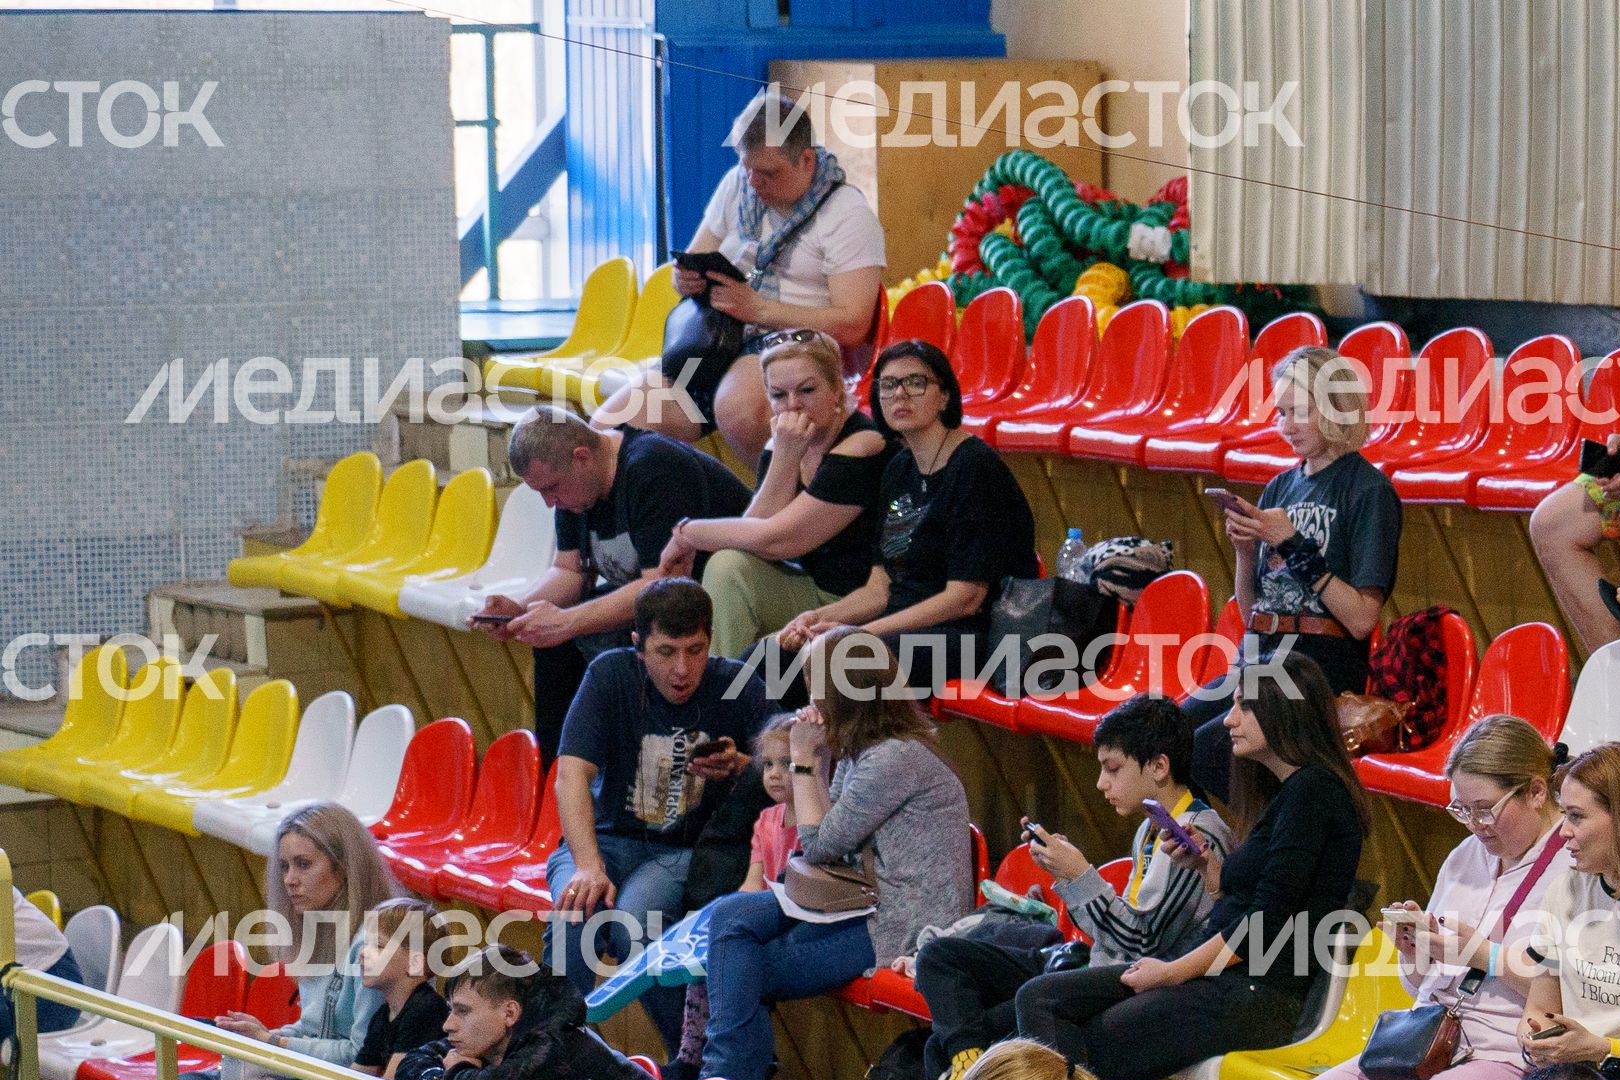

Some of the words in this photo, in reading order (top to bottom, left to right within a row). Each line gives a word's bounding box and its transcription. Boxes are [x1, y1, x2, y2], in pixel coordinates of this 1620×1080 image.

[662, 726, 687, 830] NSPIRATION
[1576, 959, 1616, 983] Whom
[1580, 982, 1588, 998] I
